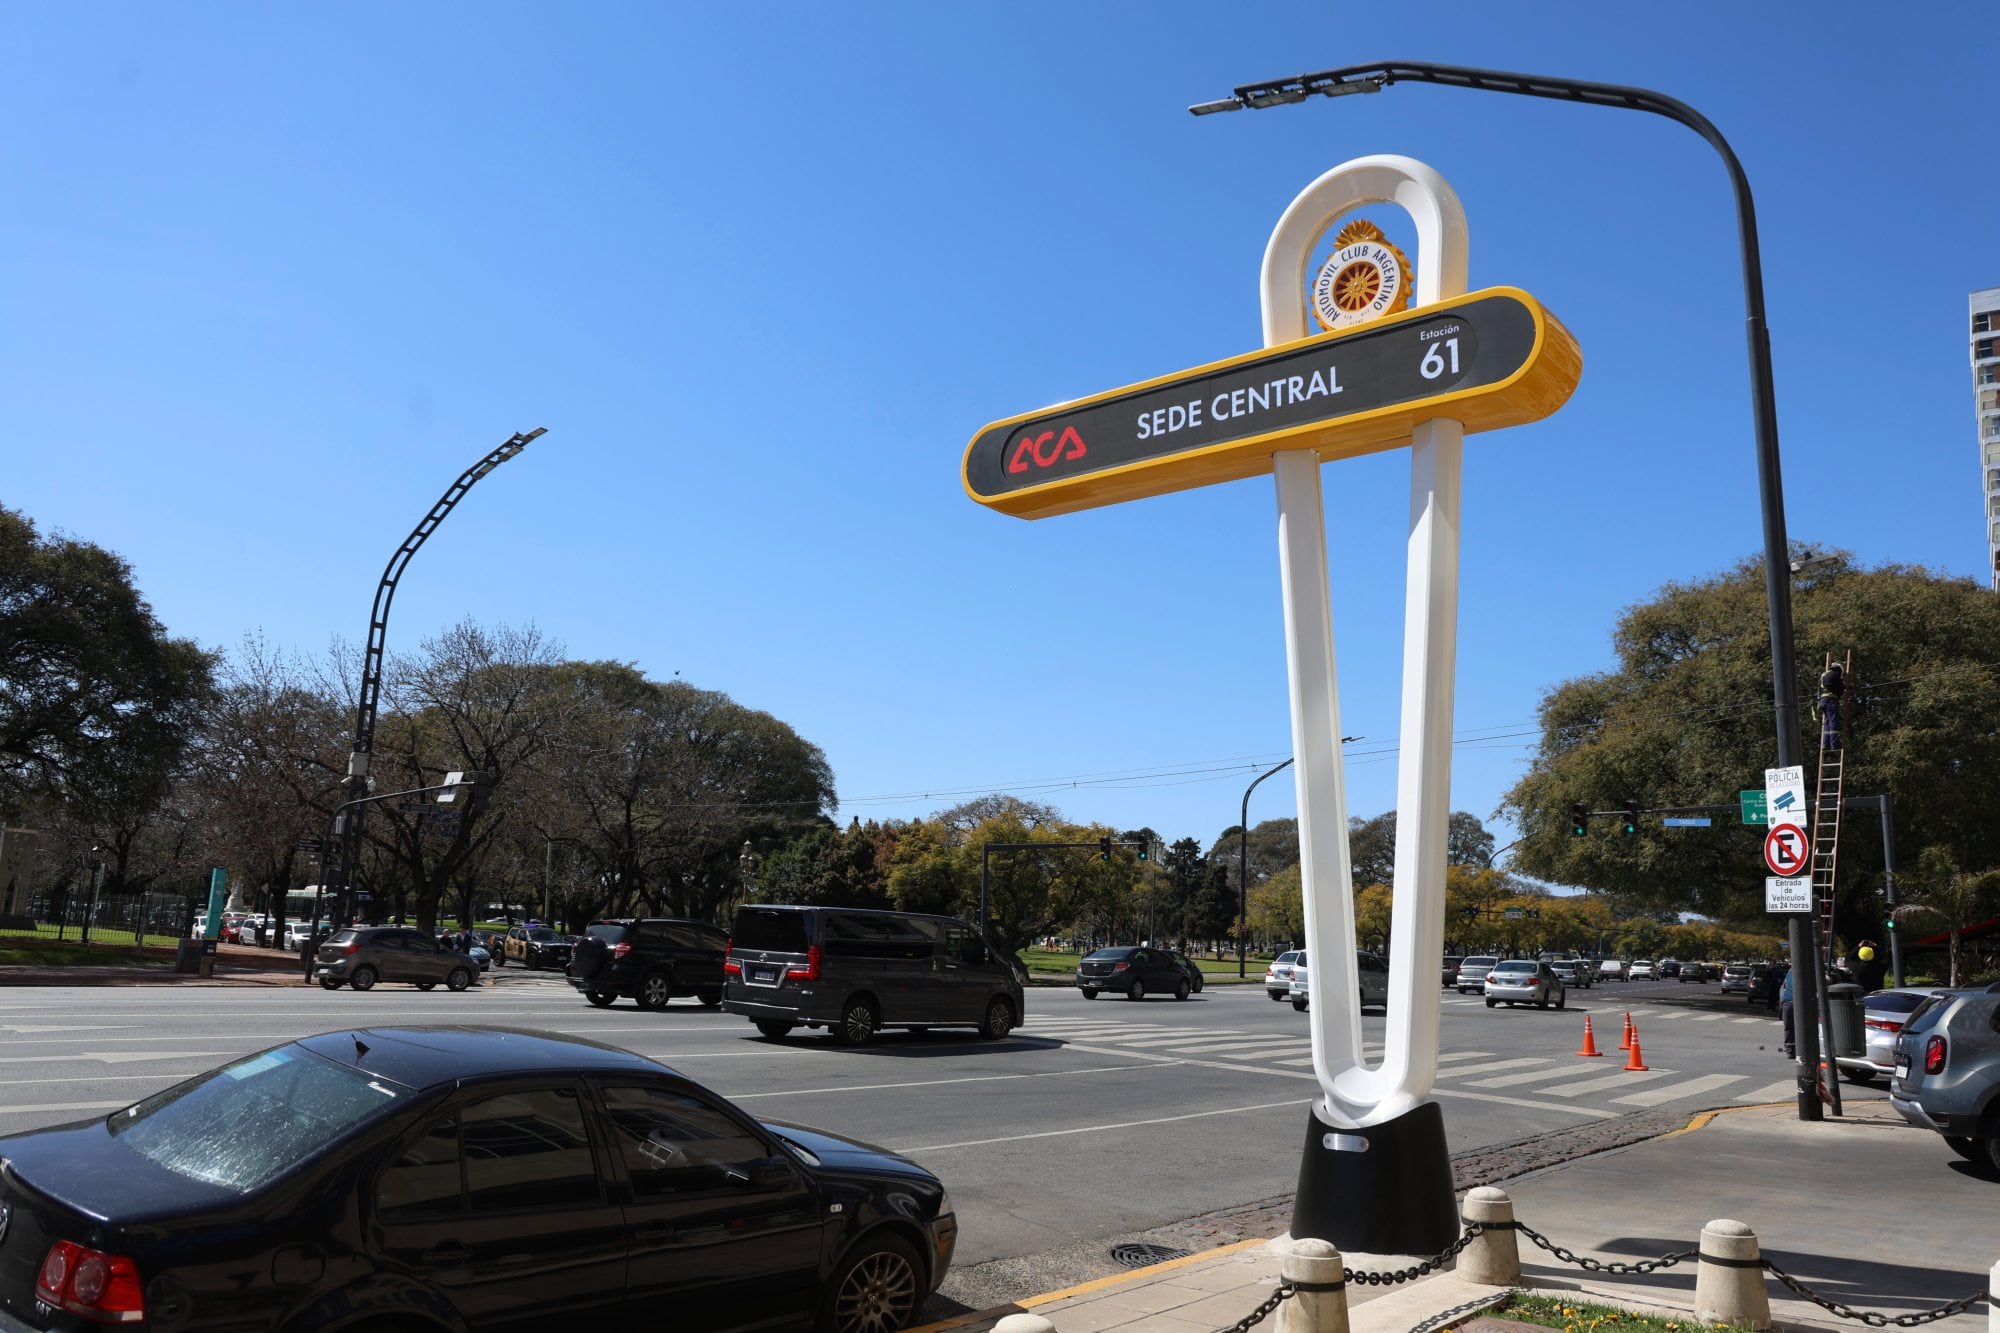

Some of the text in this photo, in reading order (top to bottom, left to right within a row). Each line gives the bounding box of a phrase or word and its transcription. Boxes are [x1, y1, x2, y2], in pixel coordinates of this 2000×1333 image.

[1318, 245, 1395, 322] AUTOMOVIL CLUB ARGENTINO
[1420, 324, 1460, 341] Estación
[1420, 337, 1459, 380] 61
[1136, 366, 1344, 440] SEDE CENTRAL
[1008, 426, 1088, 474] ACA
[1776, 833, 1797, 864] E
[1775, 879, 1802, 887] Entrada
[1779, 901, 1788, 909] 24
[1789, 901, 1809, 909] horas
